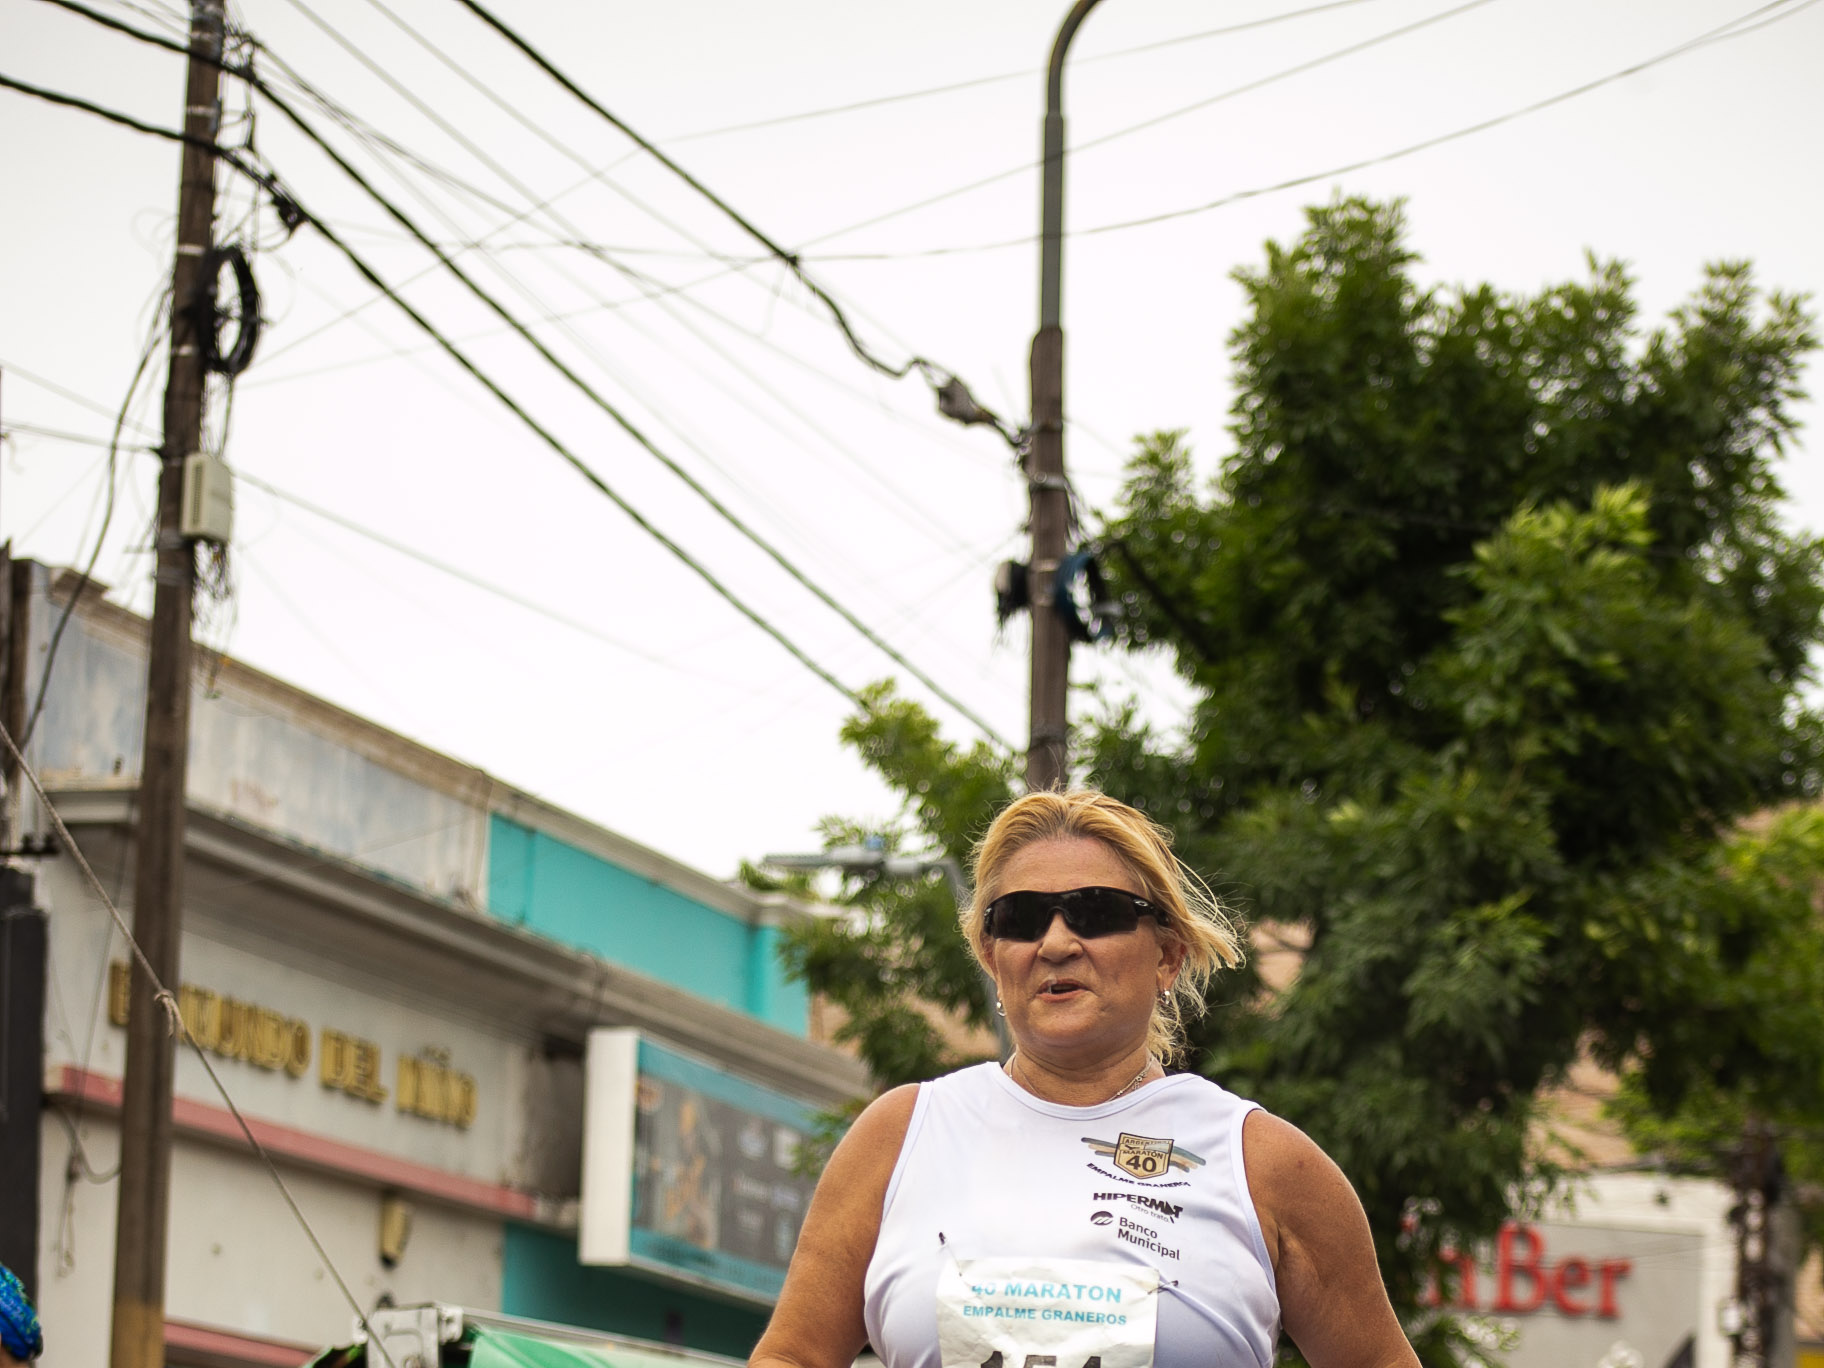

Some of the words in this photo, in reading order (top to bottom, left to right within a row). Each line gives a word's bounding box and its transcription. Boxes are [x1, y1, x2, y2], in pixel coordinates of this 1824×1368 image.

[320, 1028, 387, 1103] DEL
[1125, 1155, 1157, 1173] 40
[1130, 1203, 1149, 1215] Otro
[1119, 1216, 1158, 1239] Banco
[1117, 1227, 1180, 1260] Municipal
[1004, 1282, 1122, 1303] MARATON
[963, 1305, 1036, 1320] EMPALME
[1041, 1309, 1127, 1326] GRANEROS
